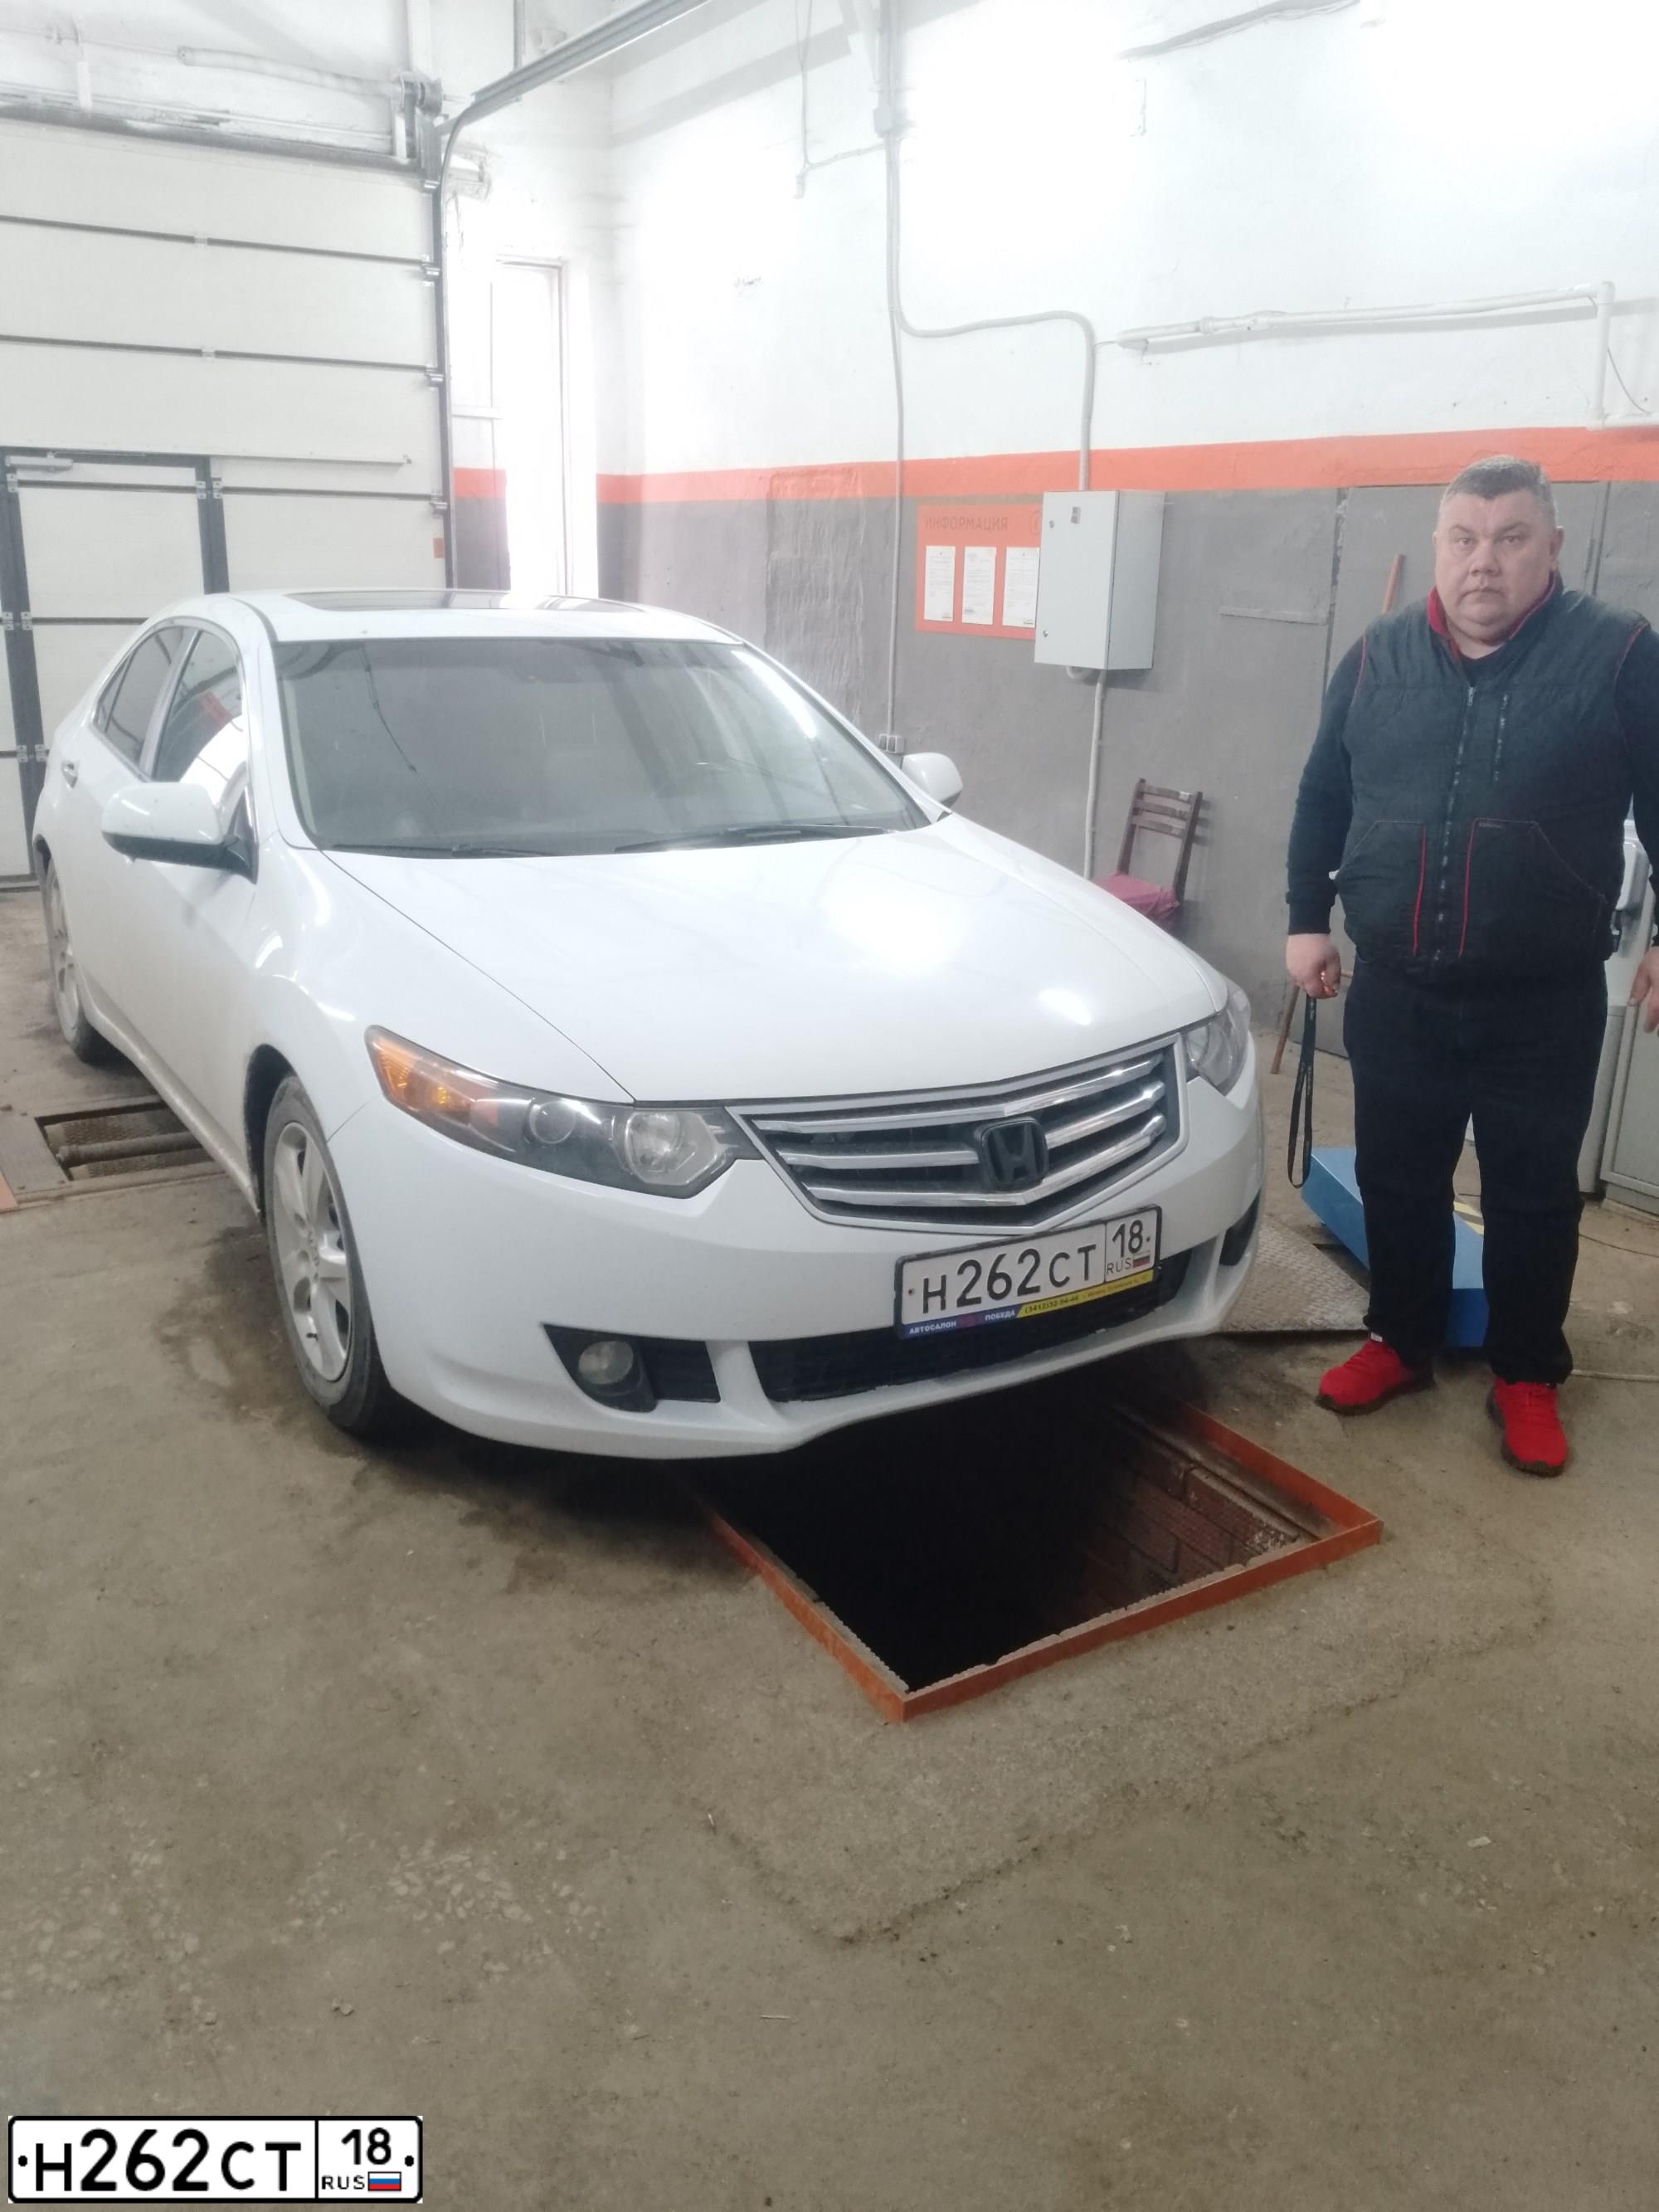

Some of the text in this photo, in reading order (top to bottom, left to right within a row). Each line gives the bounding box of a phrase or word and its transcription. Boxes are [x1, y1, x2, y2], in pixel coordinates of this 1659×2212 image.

[925, 516, 1009, 531] ИНФОРМАЦИЯ
[1112, 1220, 1144, 1257] 18
[1107, 1258, 1132, 1274] RUS
[909, 1320, 956, 1335] АВТОСАЛОН
[985, 1309, 1015, 1321] ПОБЕДА
